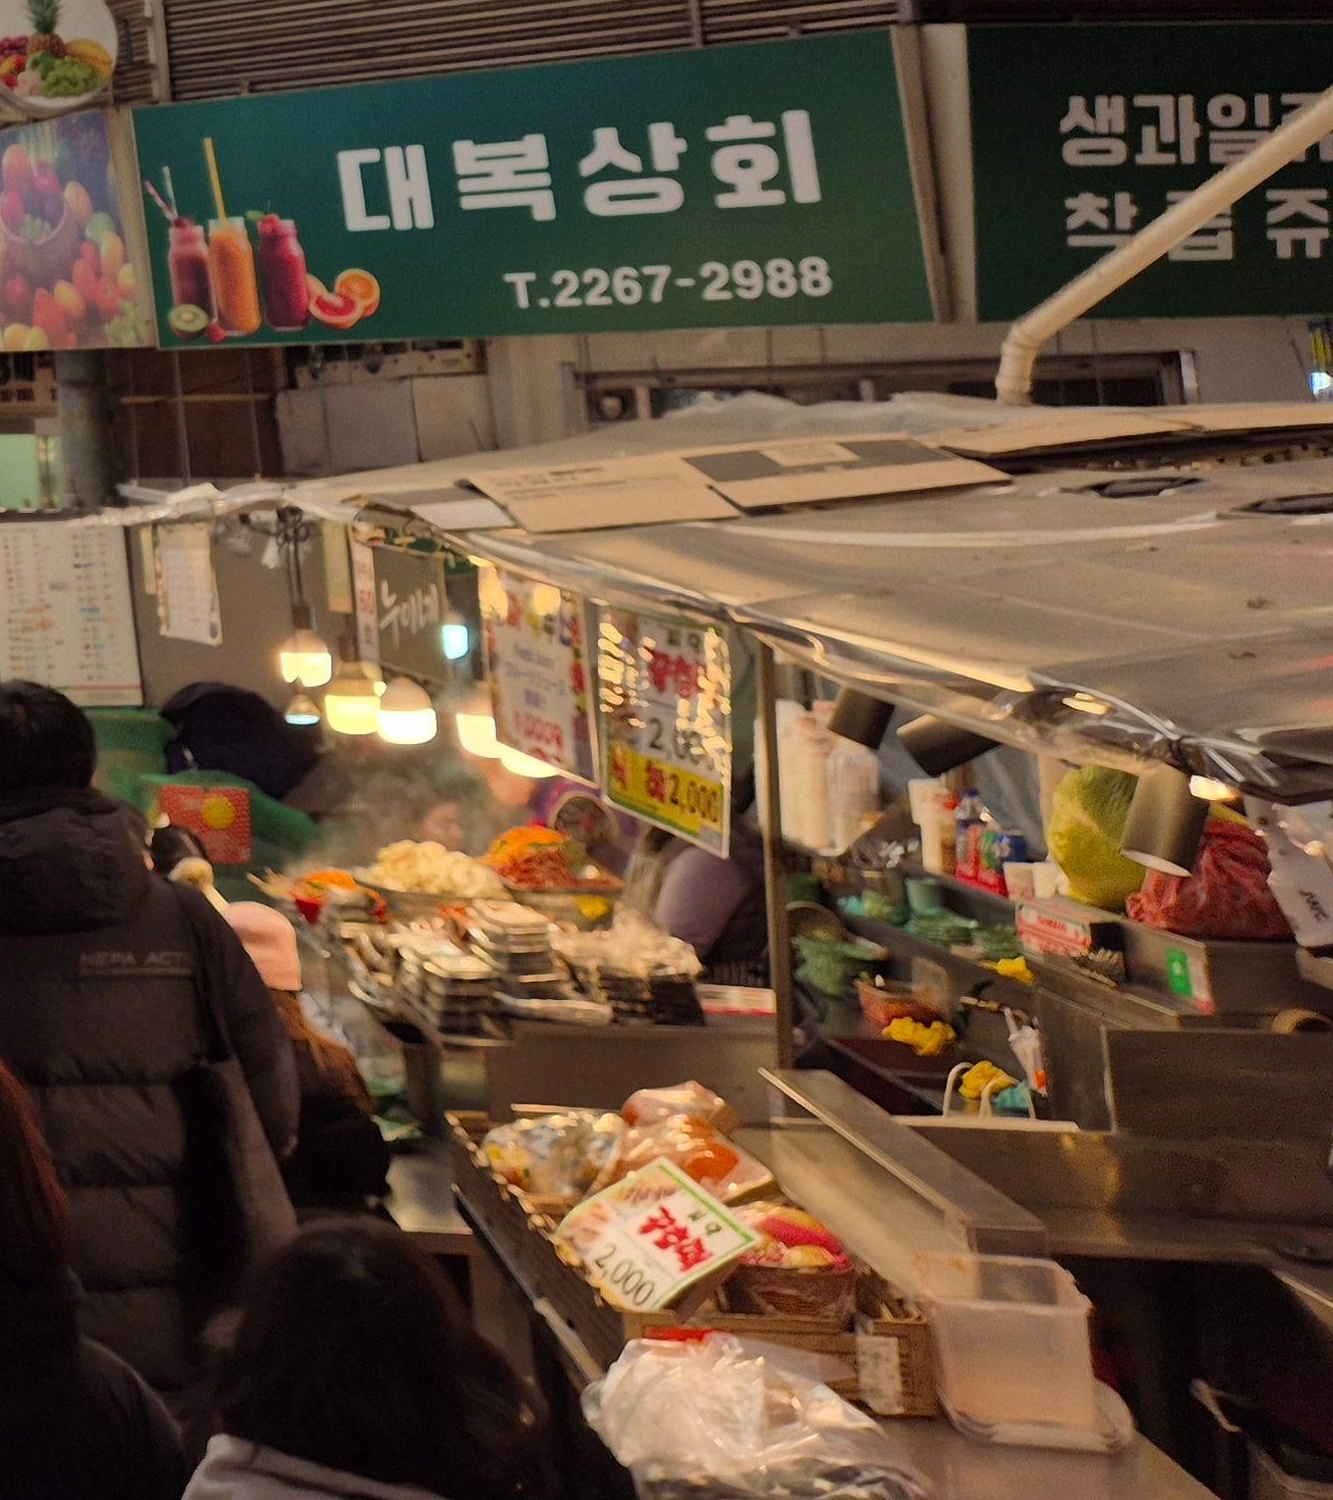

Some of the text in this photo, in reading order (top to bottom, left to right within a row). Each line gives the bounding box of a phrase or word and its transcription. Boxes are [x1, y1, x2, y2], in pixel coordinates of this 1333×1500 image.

[336, 109, 822, 232] 대복상회
[503, 256, 833, 310] T.2267-2988
[594, 1242, 657, 1307] 2,000
